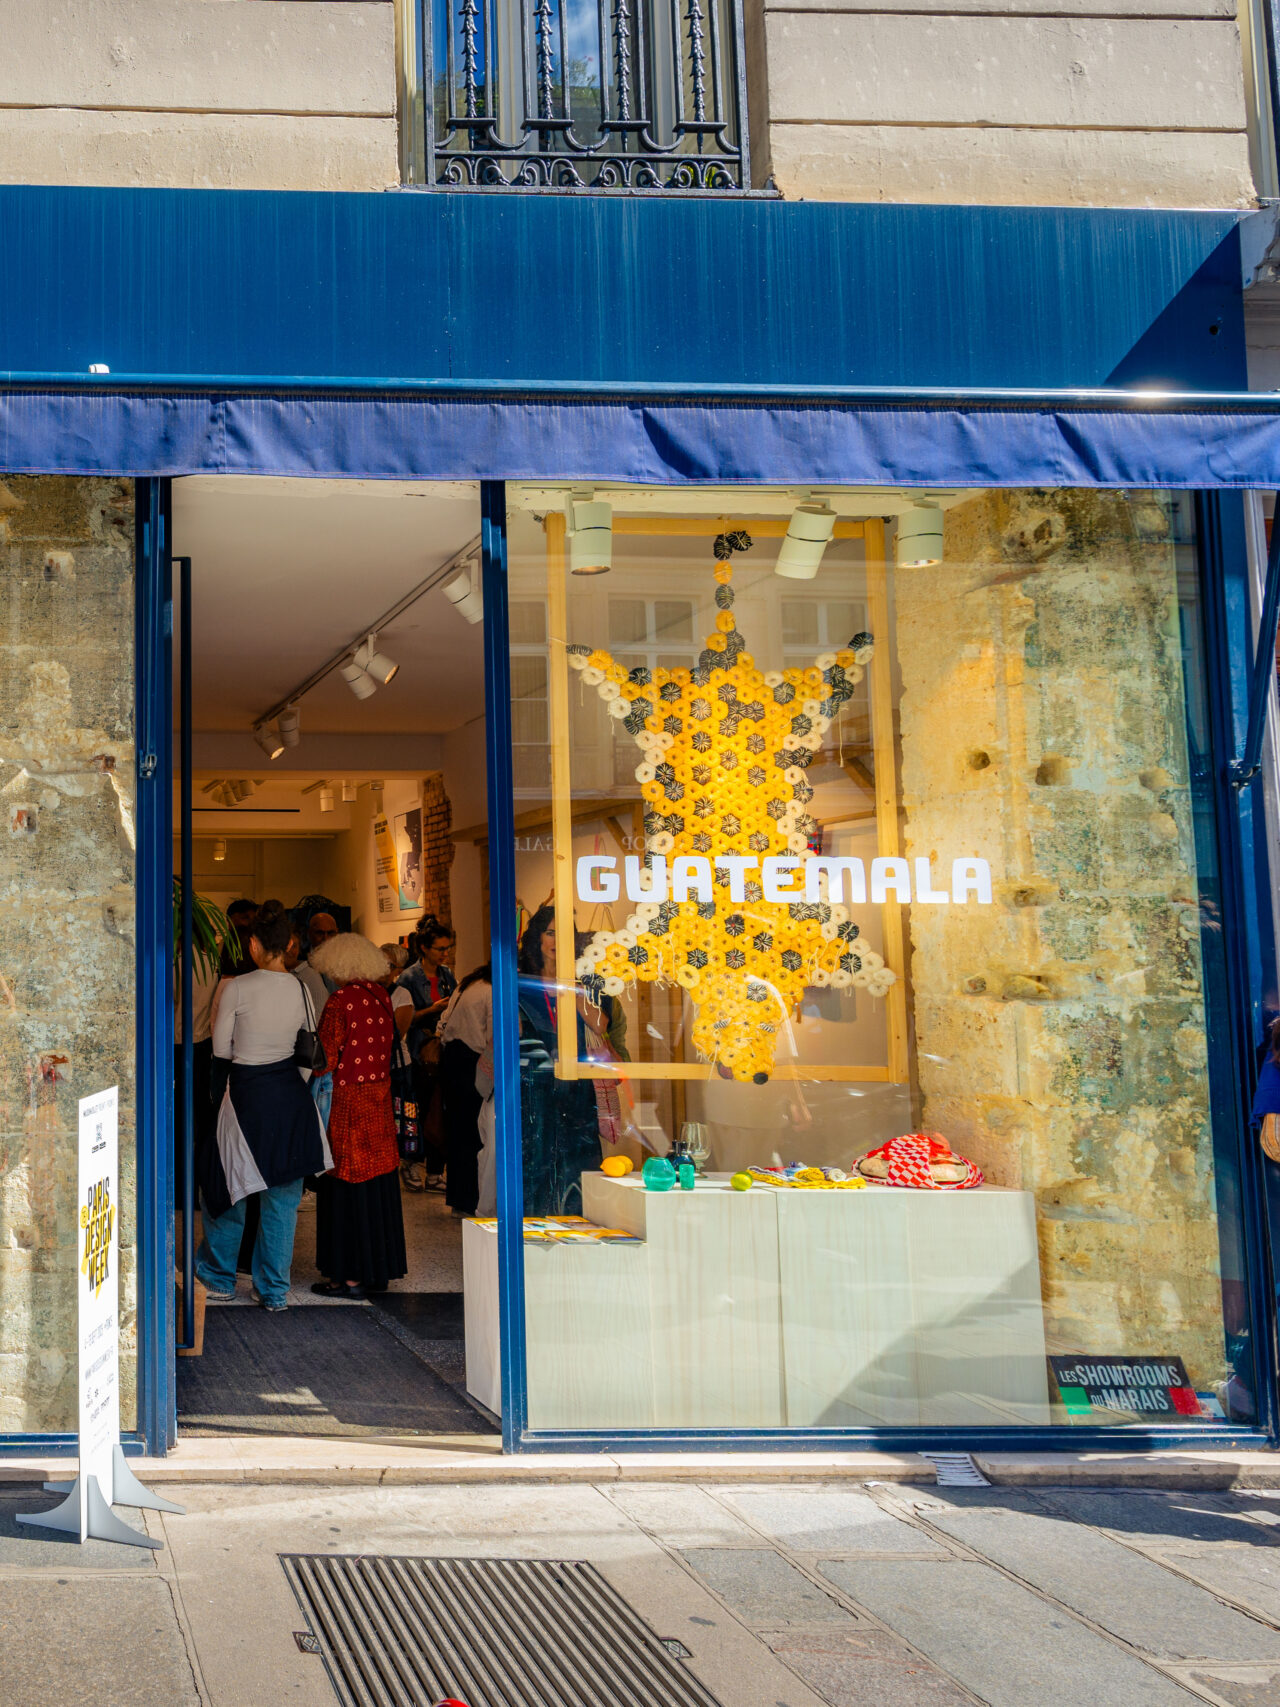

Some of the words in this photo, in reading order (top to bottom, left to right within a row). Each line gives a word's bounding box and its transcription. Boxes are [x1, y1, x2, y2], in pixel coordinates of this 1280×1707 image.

[576, 855, 993, 904] GUATEMALA
[87, 1176, 110, 1221] PARIS
[85, 1208, 112, 1259] DESIGN
[88, 1246, 110, 1292] WEEK
[1058, 1370, 1079, 1383] LES
[1074, 1365, 1183, 1386] SHOWROOMS
[1090, 1394, 1105, 1407] DU
[1102, 1389, 1169, 1410] MARAIS
